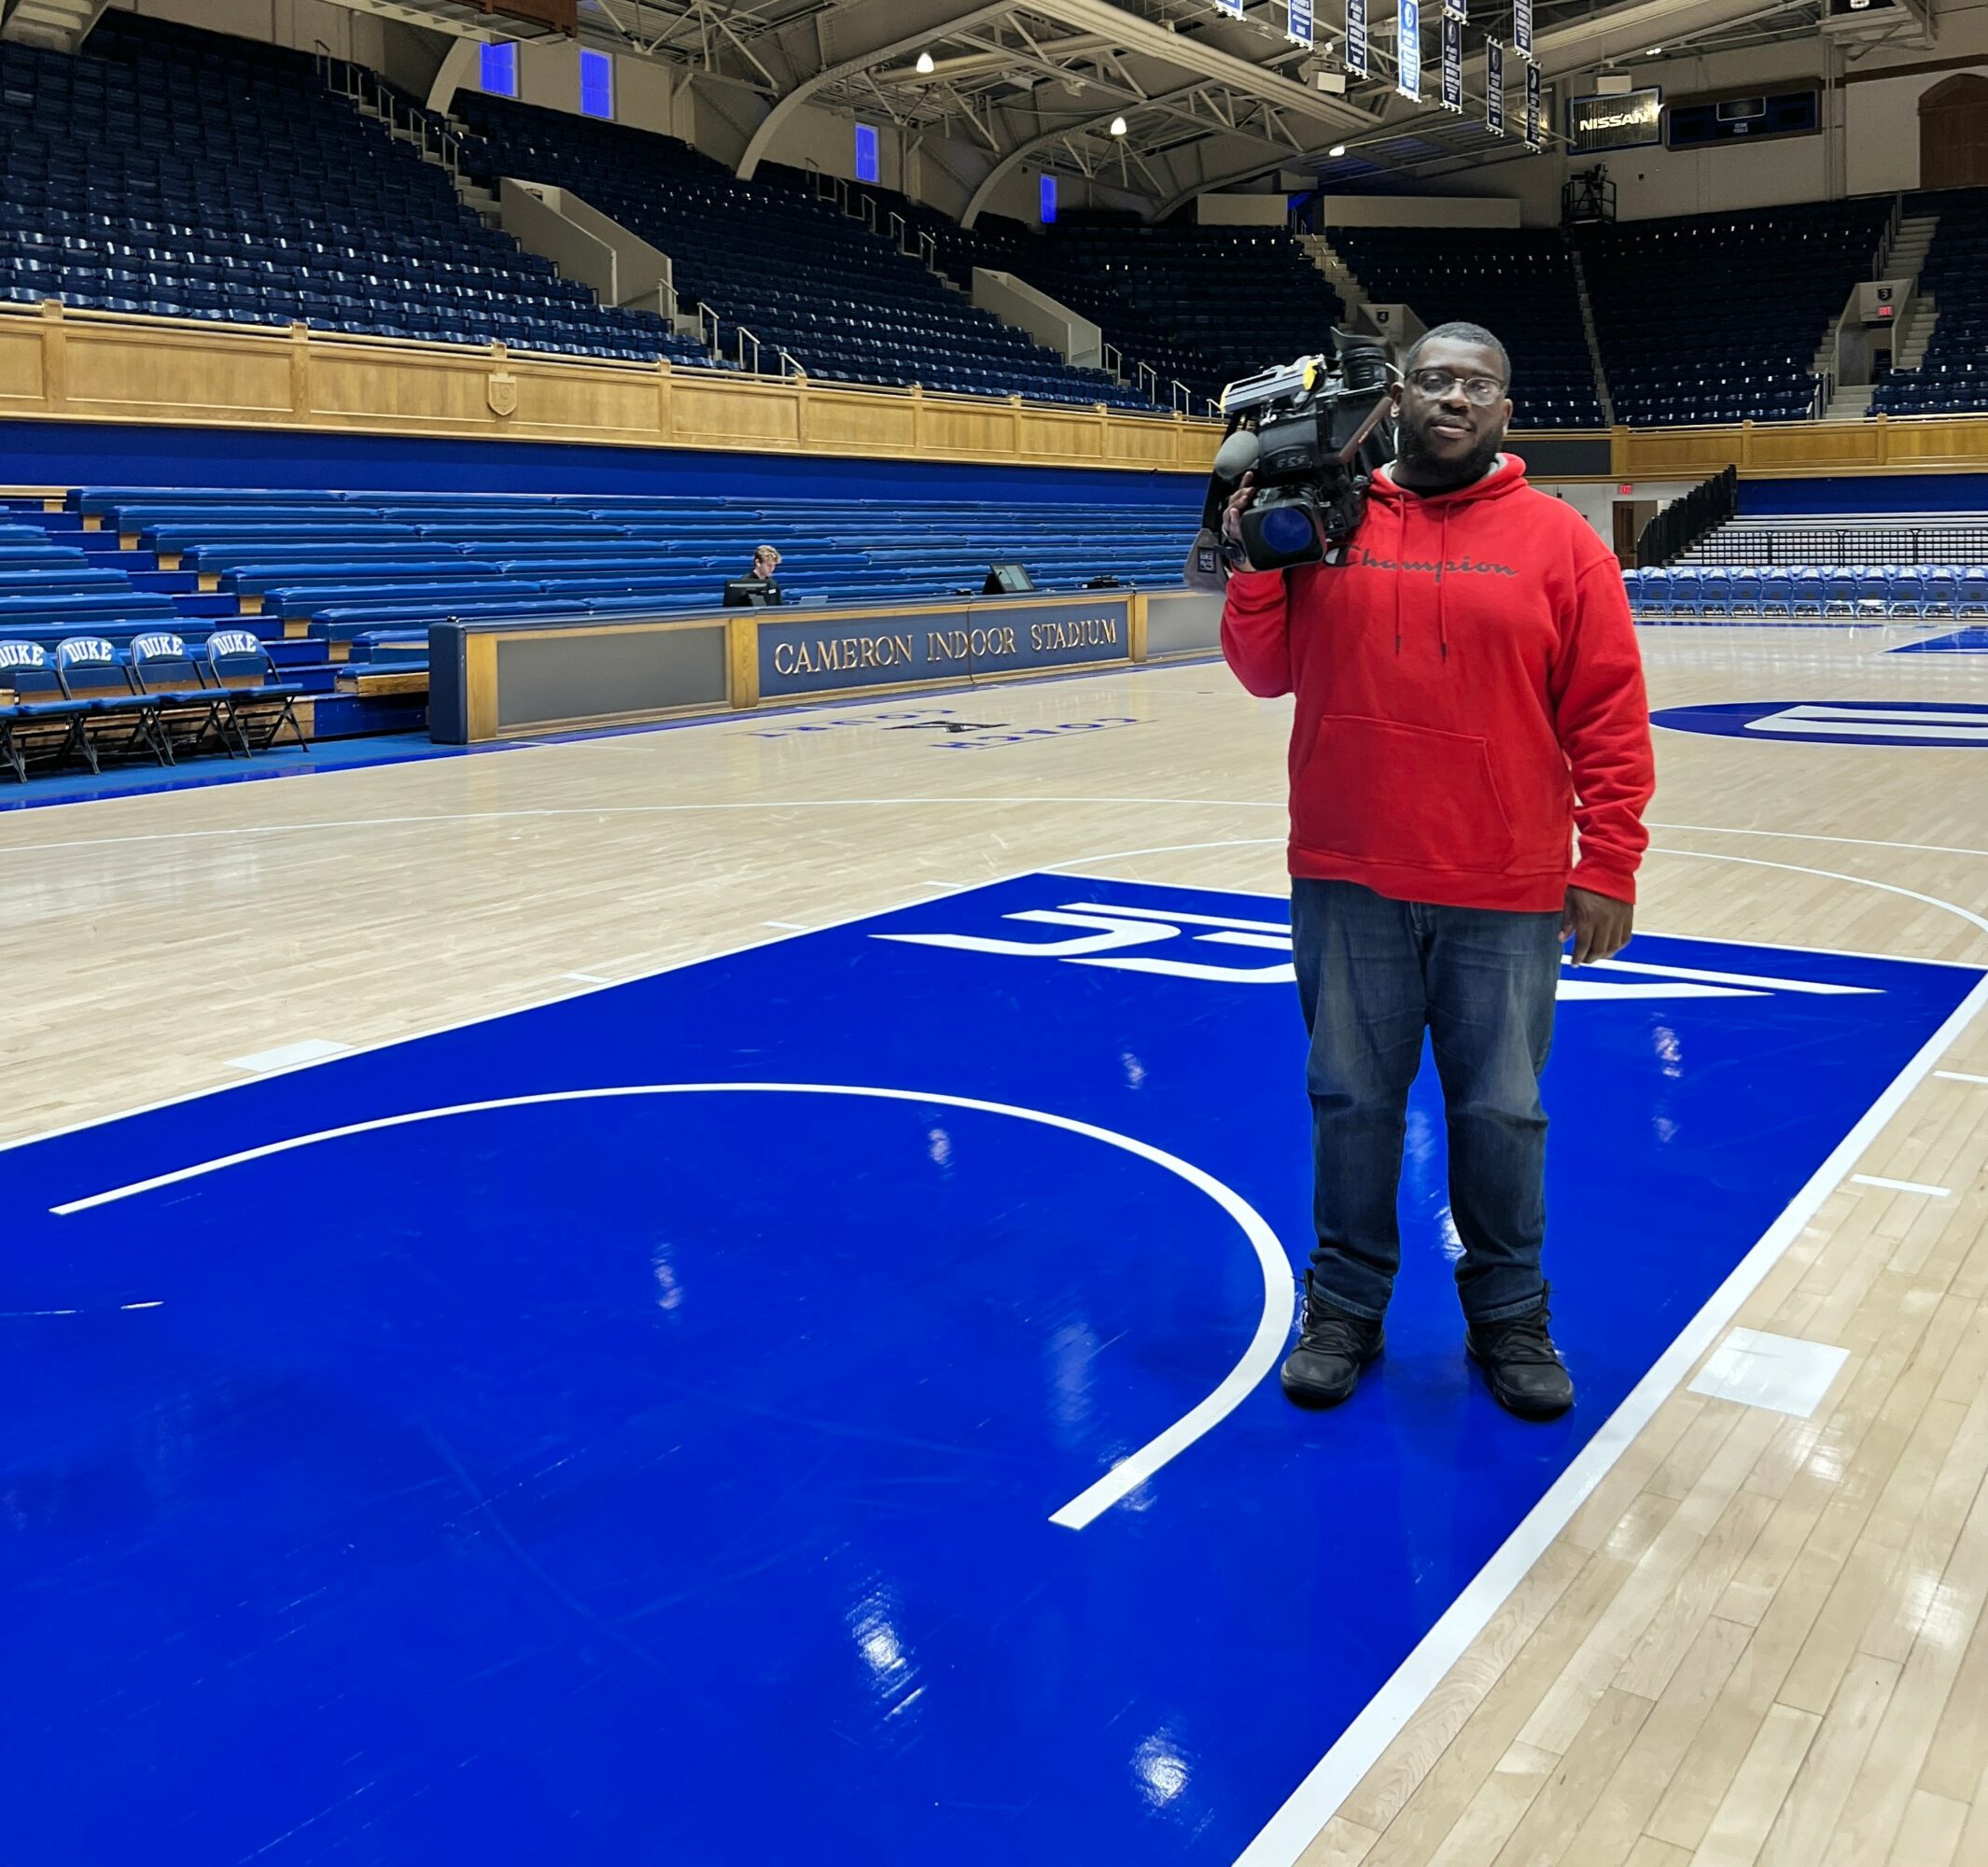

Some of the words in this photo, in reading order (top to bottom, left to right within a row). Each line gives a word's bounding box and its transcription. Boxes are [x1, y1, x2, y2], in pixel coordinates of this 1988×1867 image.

[1579, 111, 1649, 132] NISSAN
[1324, 543, 1520, 583] Champion
[63, 639, 114, 662] DUKE
[138, 635, 184, 659] DUKE
[212, 633, 258, 655] DUKE
[774, 634, 913, 676] CAMERON
[927, 626, 1017, 662] INDOOR
[1030, 618, 1117, 652] STADIUM
